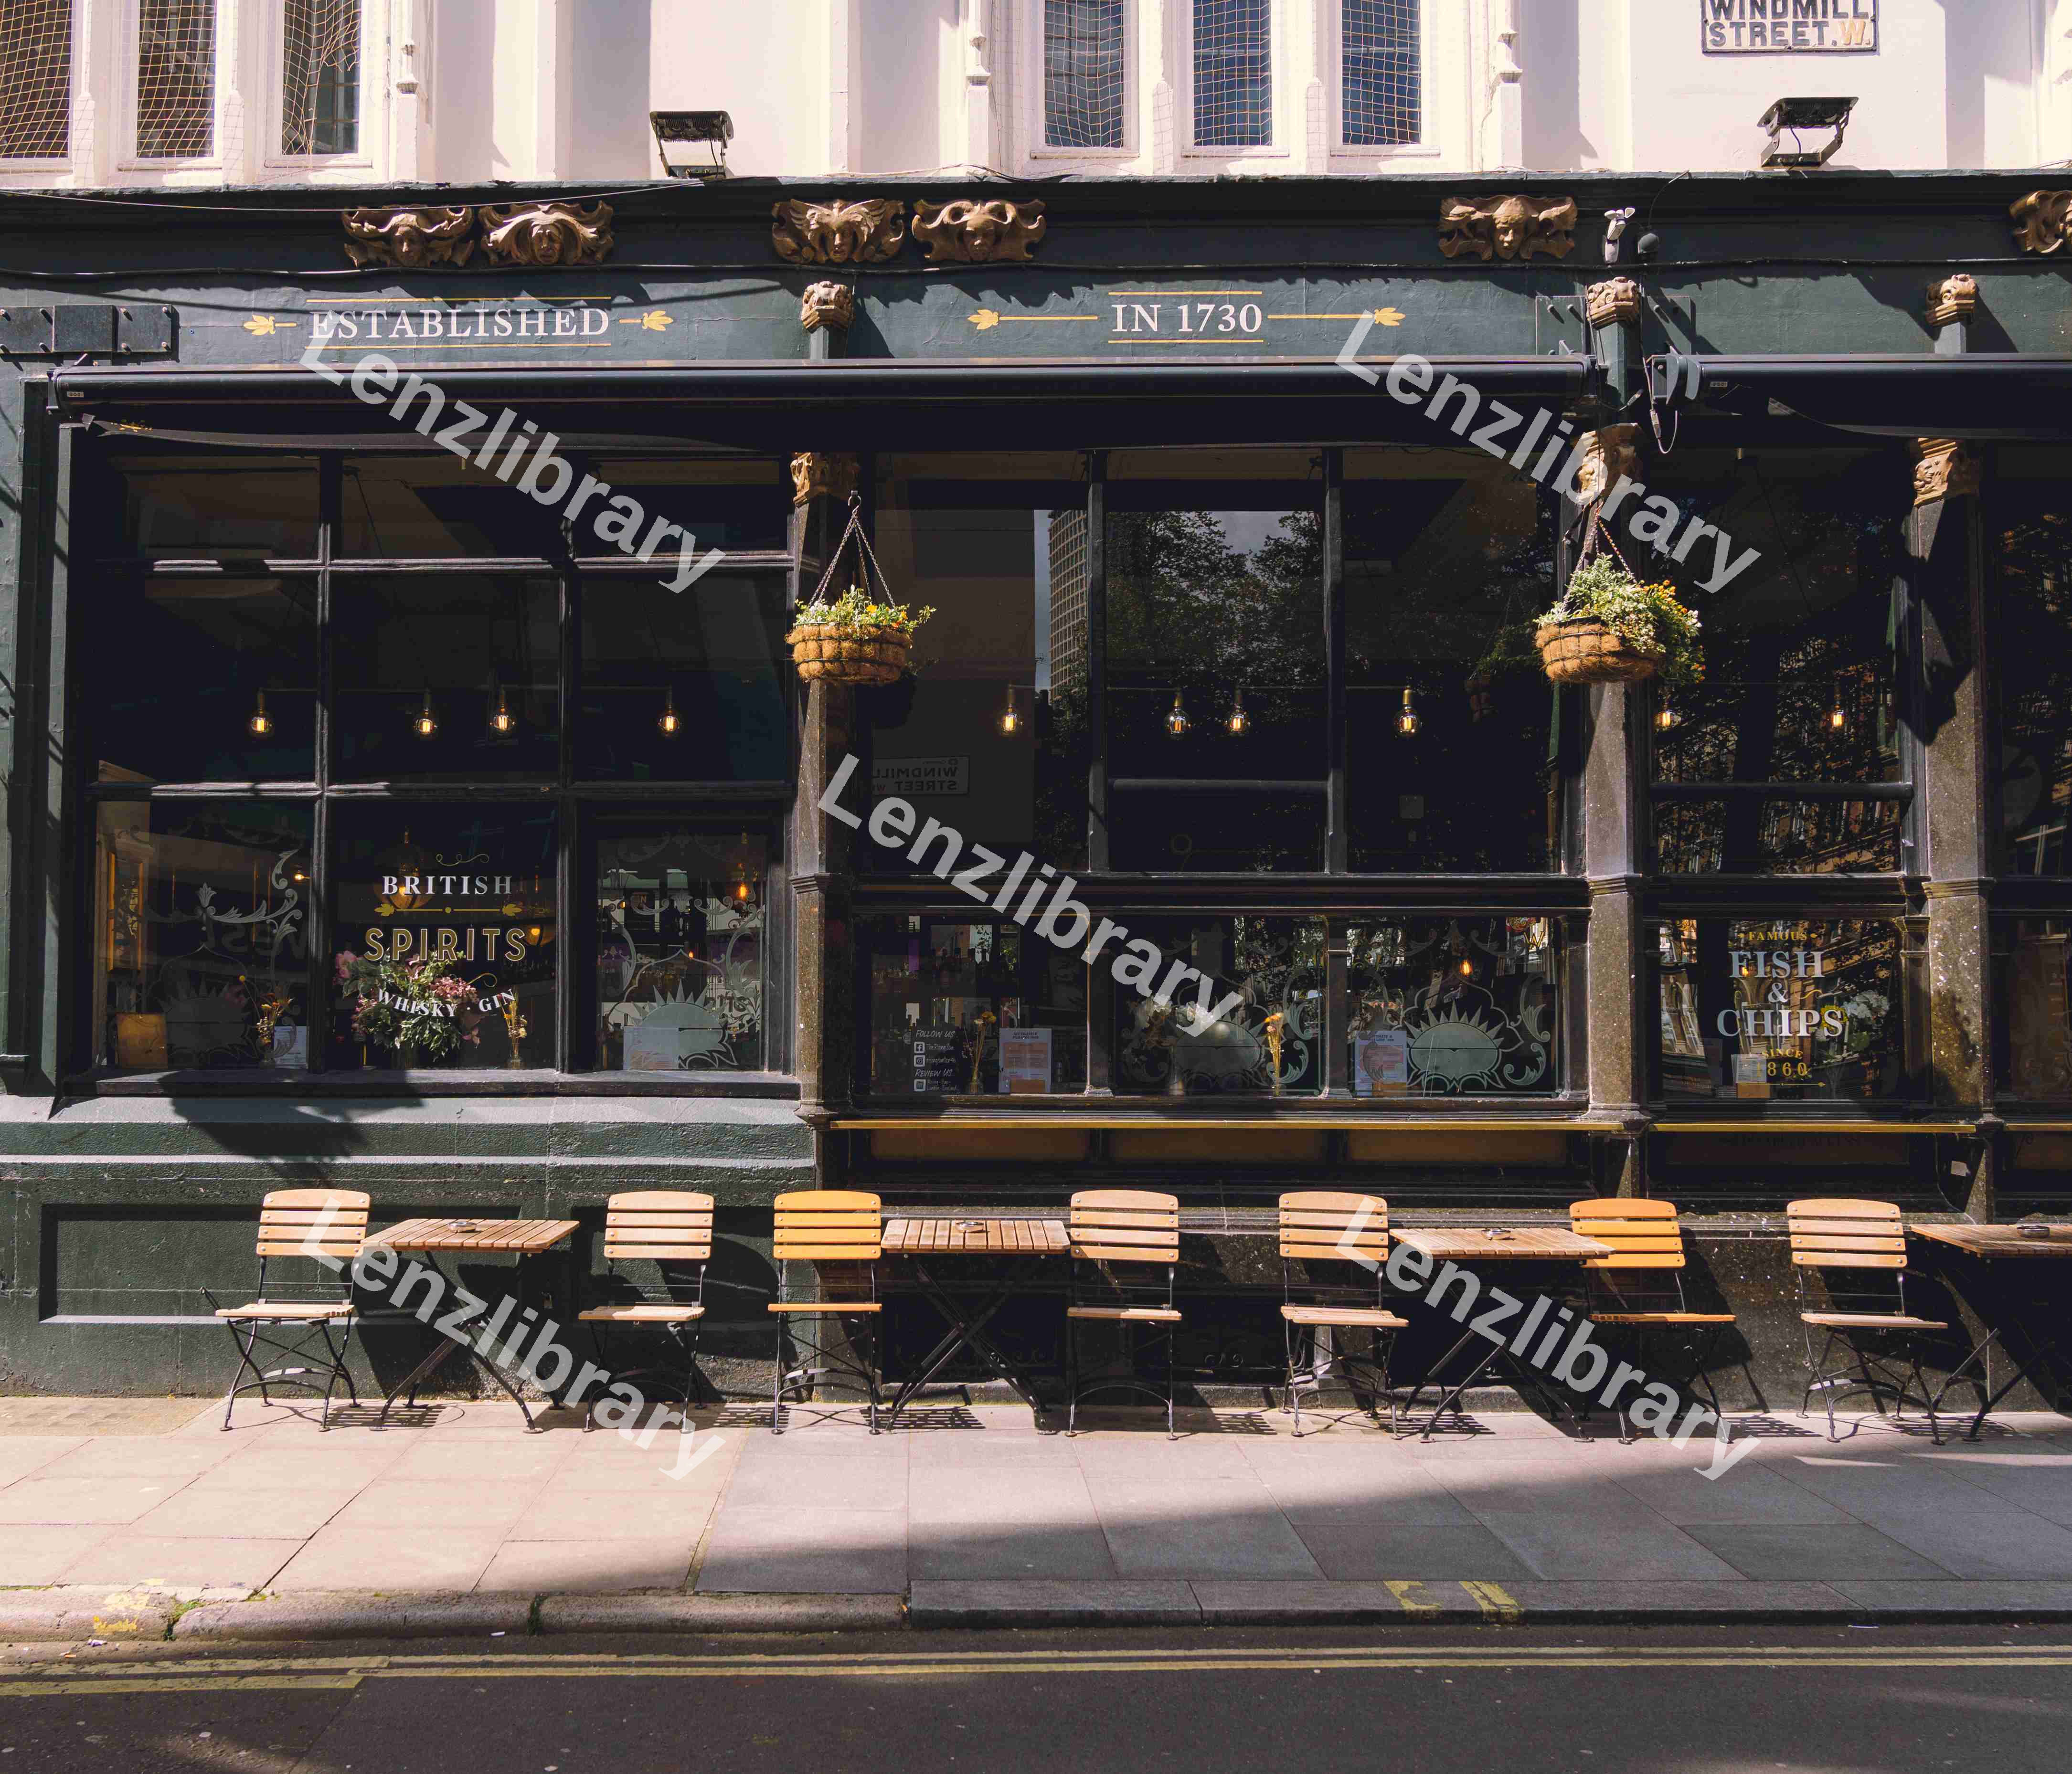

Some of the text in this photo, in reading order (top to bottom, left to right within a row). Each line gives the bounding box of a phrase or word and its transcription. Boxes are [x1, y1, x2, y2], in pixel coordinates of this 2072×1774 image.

[1708, 0, 1869, 20] WINDMILL
[308, 307, 610, 339] ESTABLISHED
[1111, 303, 1262, 333] IN 1730
[382, 876, 512, 895] BRITISH
[363, 928, 526, 961] SPIRITS
[1748, 931, 1807, 940] FAMOUS
[1729, 950, 1826, 978] FISH
[378, 988, 516, 1017] WHISKY GIN
[1767, 982, 1788, 1003] &
[916, 1029, 942, 1038] FOLLOW
[1717, 1009, 1843, 1037] CHIPS
[1762, 1048, 1804, 1059] SINCE
[915, 1069, 941, 1077] REVIEW
